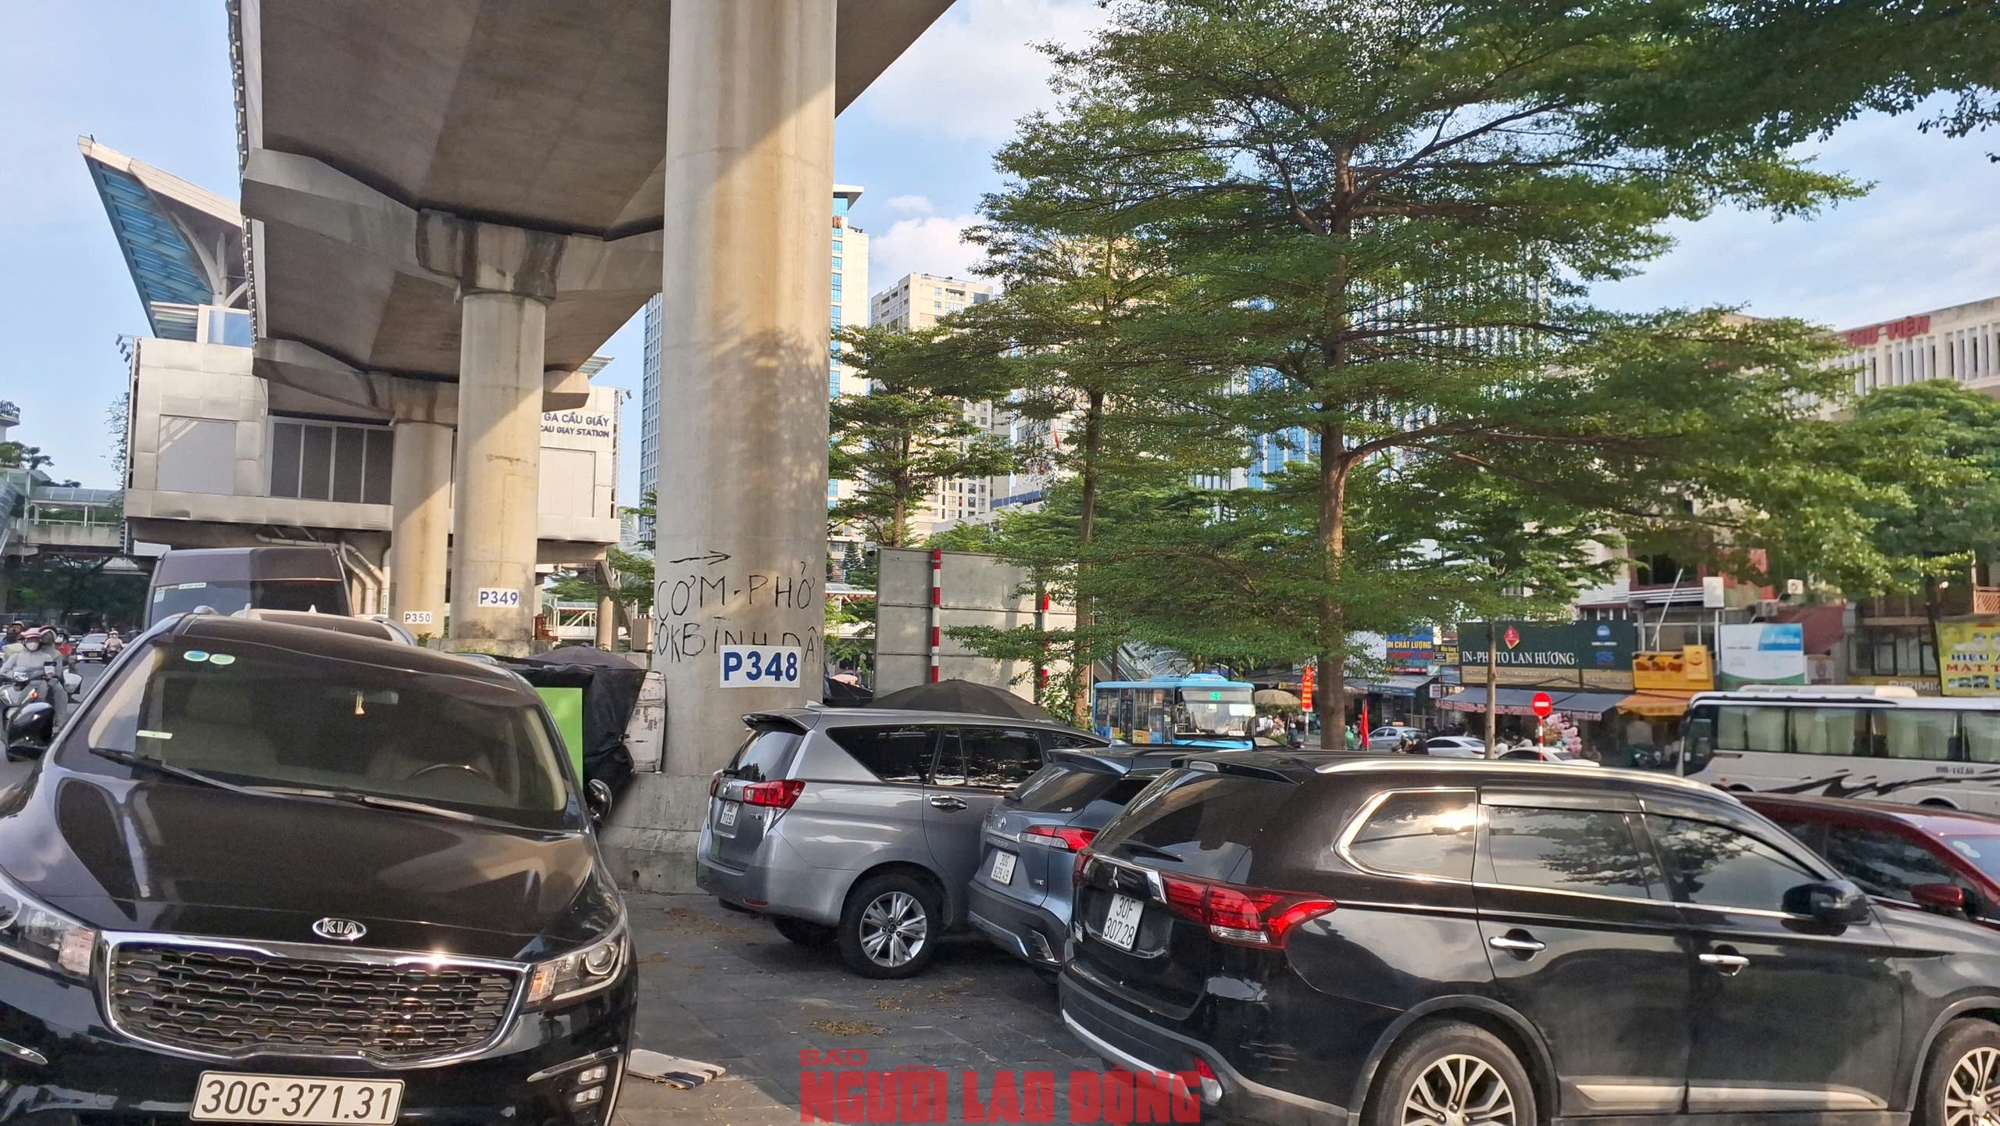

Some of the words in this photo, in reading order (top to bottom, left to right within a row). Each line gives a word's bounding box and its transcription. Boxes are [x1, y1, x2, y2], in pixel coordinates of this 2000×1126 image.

[544, 413, 559, 422] GA
[576, 428, 610, 438] STATION
[480, 591, 518, 605] P349
[405, 613, 431, 622] P350
[1462, 651, 1509, 664] IN-PHTO
[1511, 652, 1532, 664] LAN
[1535, 651, 1575, 665] HƯƠNG
[723, 651, 798, 682] P348
[1116, 896, 1136, 919] 30F
[322, 920, 358, 934] KIA
[1104, 917, 1135, 946] 307.28
[201, 1079, 393, 1120] 30G-371.31
